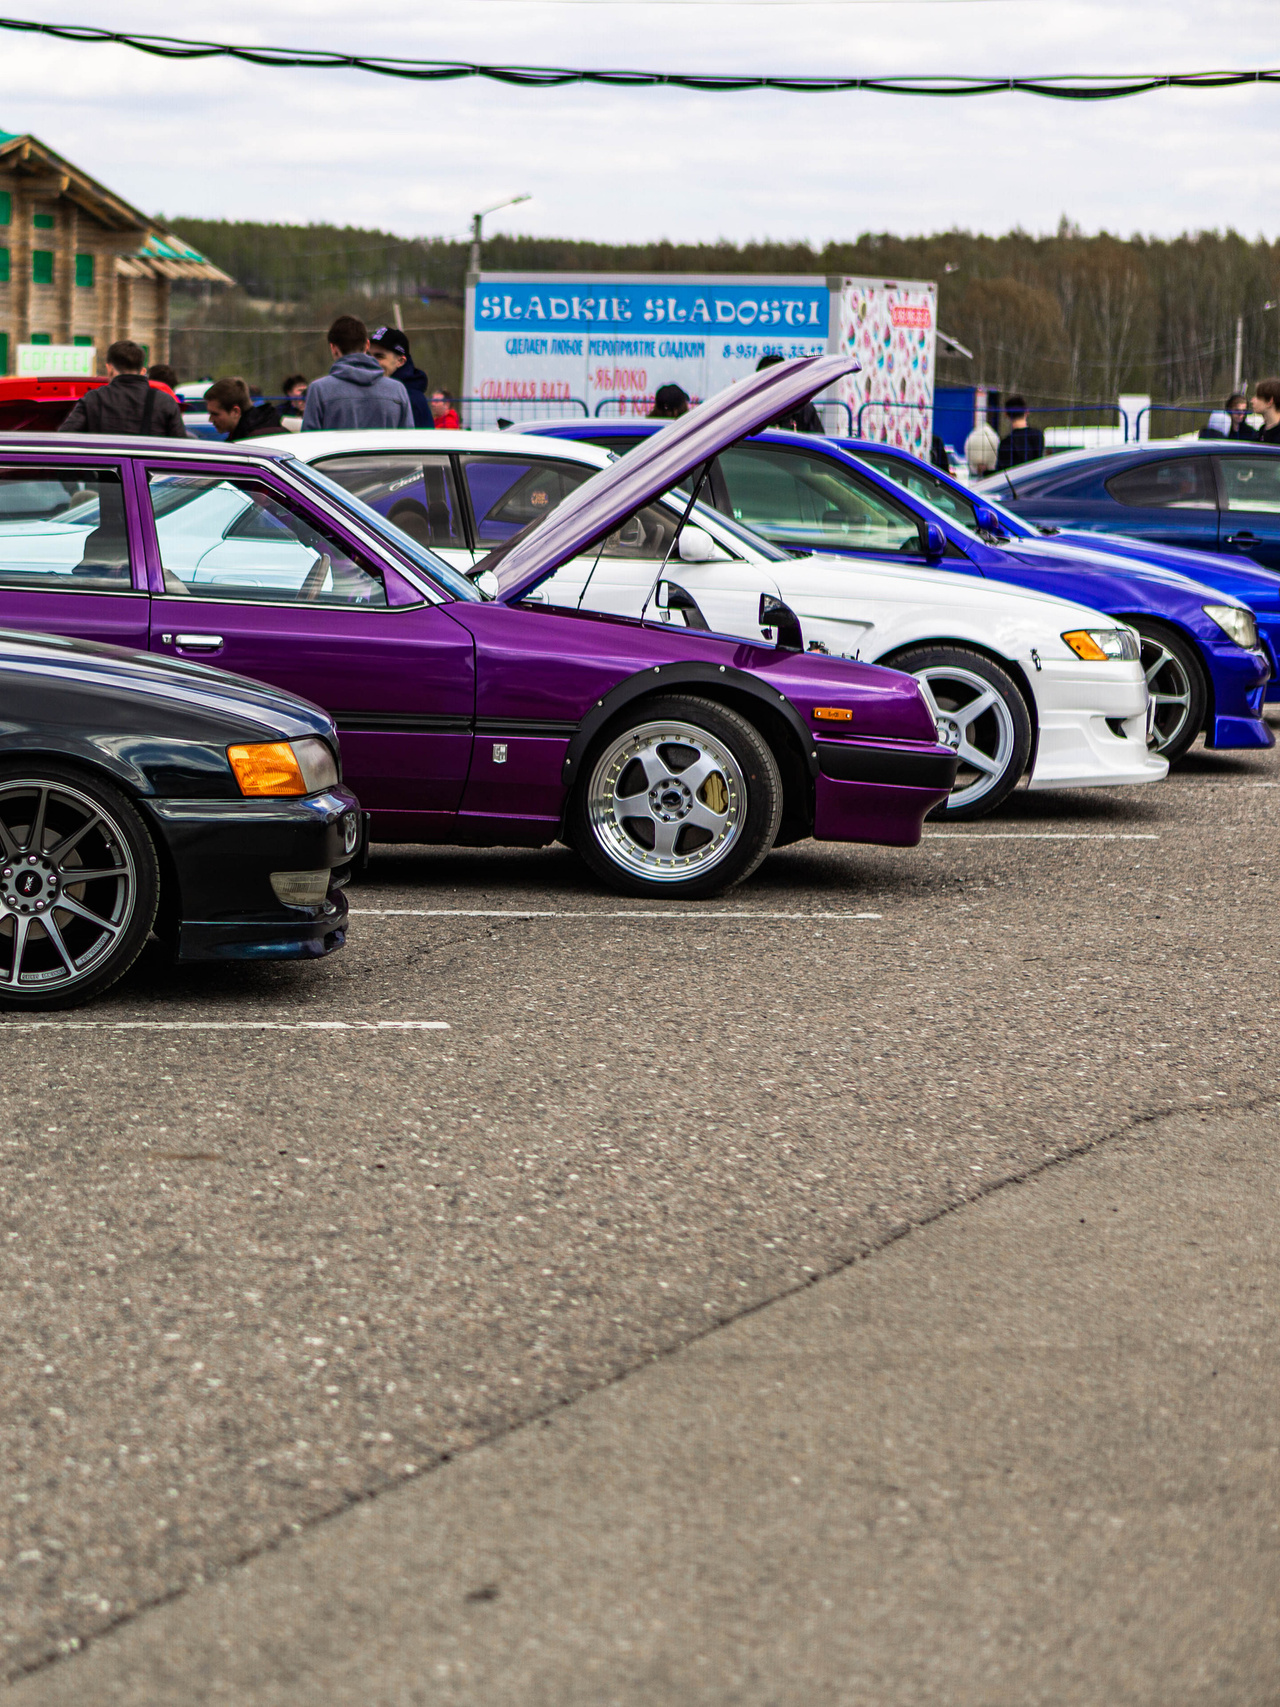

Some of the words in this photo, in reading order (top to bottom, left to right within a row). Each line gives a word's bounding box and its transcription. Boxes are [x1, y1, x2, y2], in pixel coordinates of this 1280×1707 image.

[481, 296, 632, 322] SLADKIE
[644, 298, 821, 326] SLADOSTI
[506, 338, 548, 357] СДЕЛАЕМ
[551, 339, 583, 356] ЛЮБОЕ
[588, 340, 656, 357] МЕРОПРИЯТИЕ
[659, 341, 705, 360] СЛАДКИМ
[595, 369, 647, 392] ЯБЛОКО
[481, 381, 536, 404] СЛАДКАЯ
